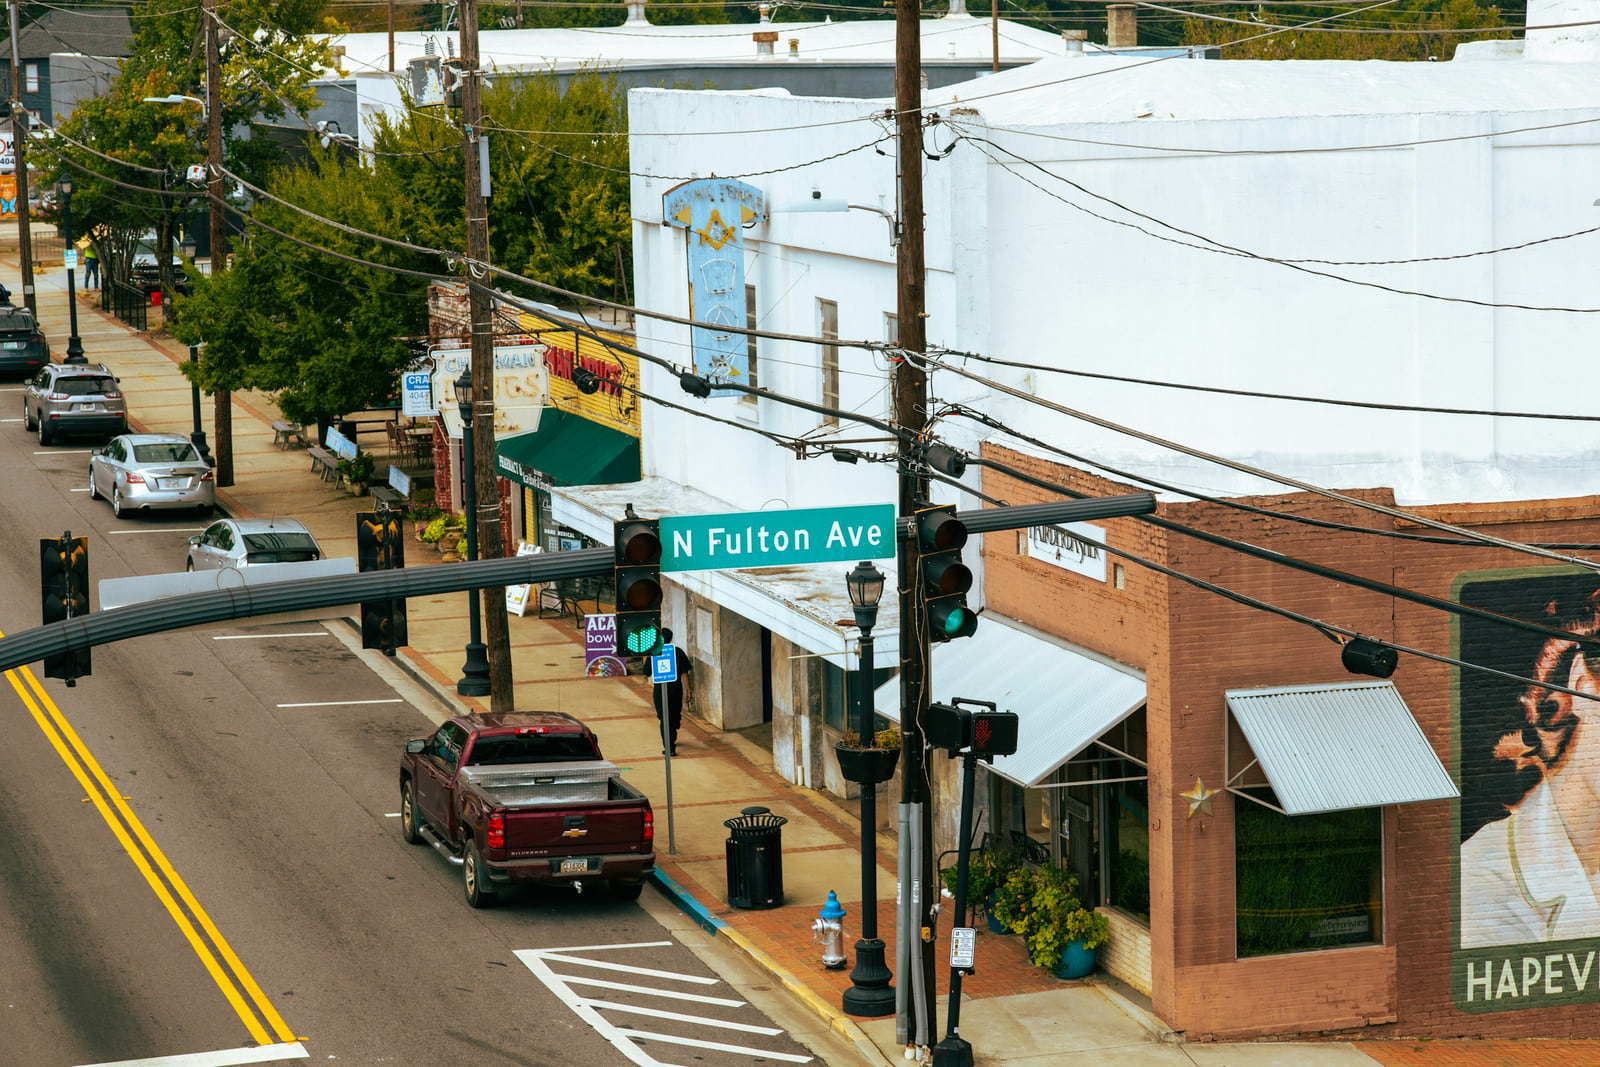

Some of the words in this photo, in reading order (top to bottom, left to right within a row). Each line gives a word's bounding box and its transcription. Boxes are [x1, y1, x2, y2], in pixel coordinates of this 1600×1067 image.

[670, 184, 714, 214] MASONIC
[719, 184, 763, 214] TEMPLE
[445, 352, 535, 372] CHMAN
[673, 529, 692, 558] N
[708, 525, 810, 556] Fulton
[826, 520, 882, 549] Ave
[1467, 951, 1600, 1002] HAPEV
